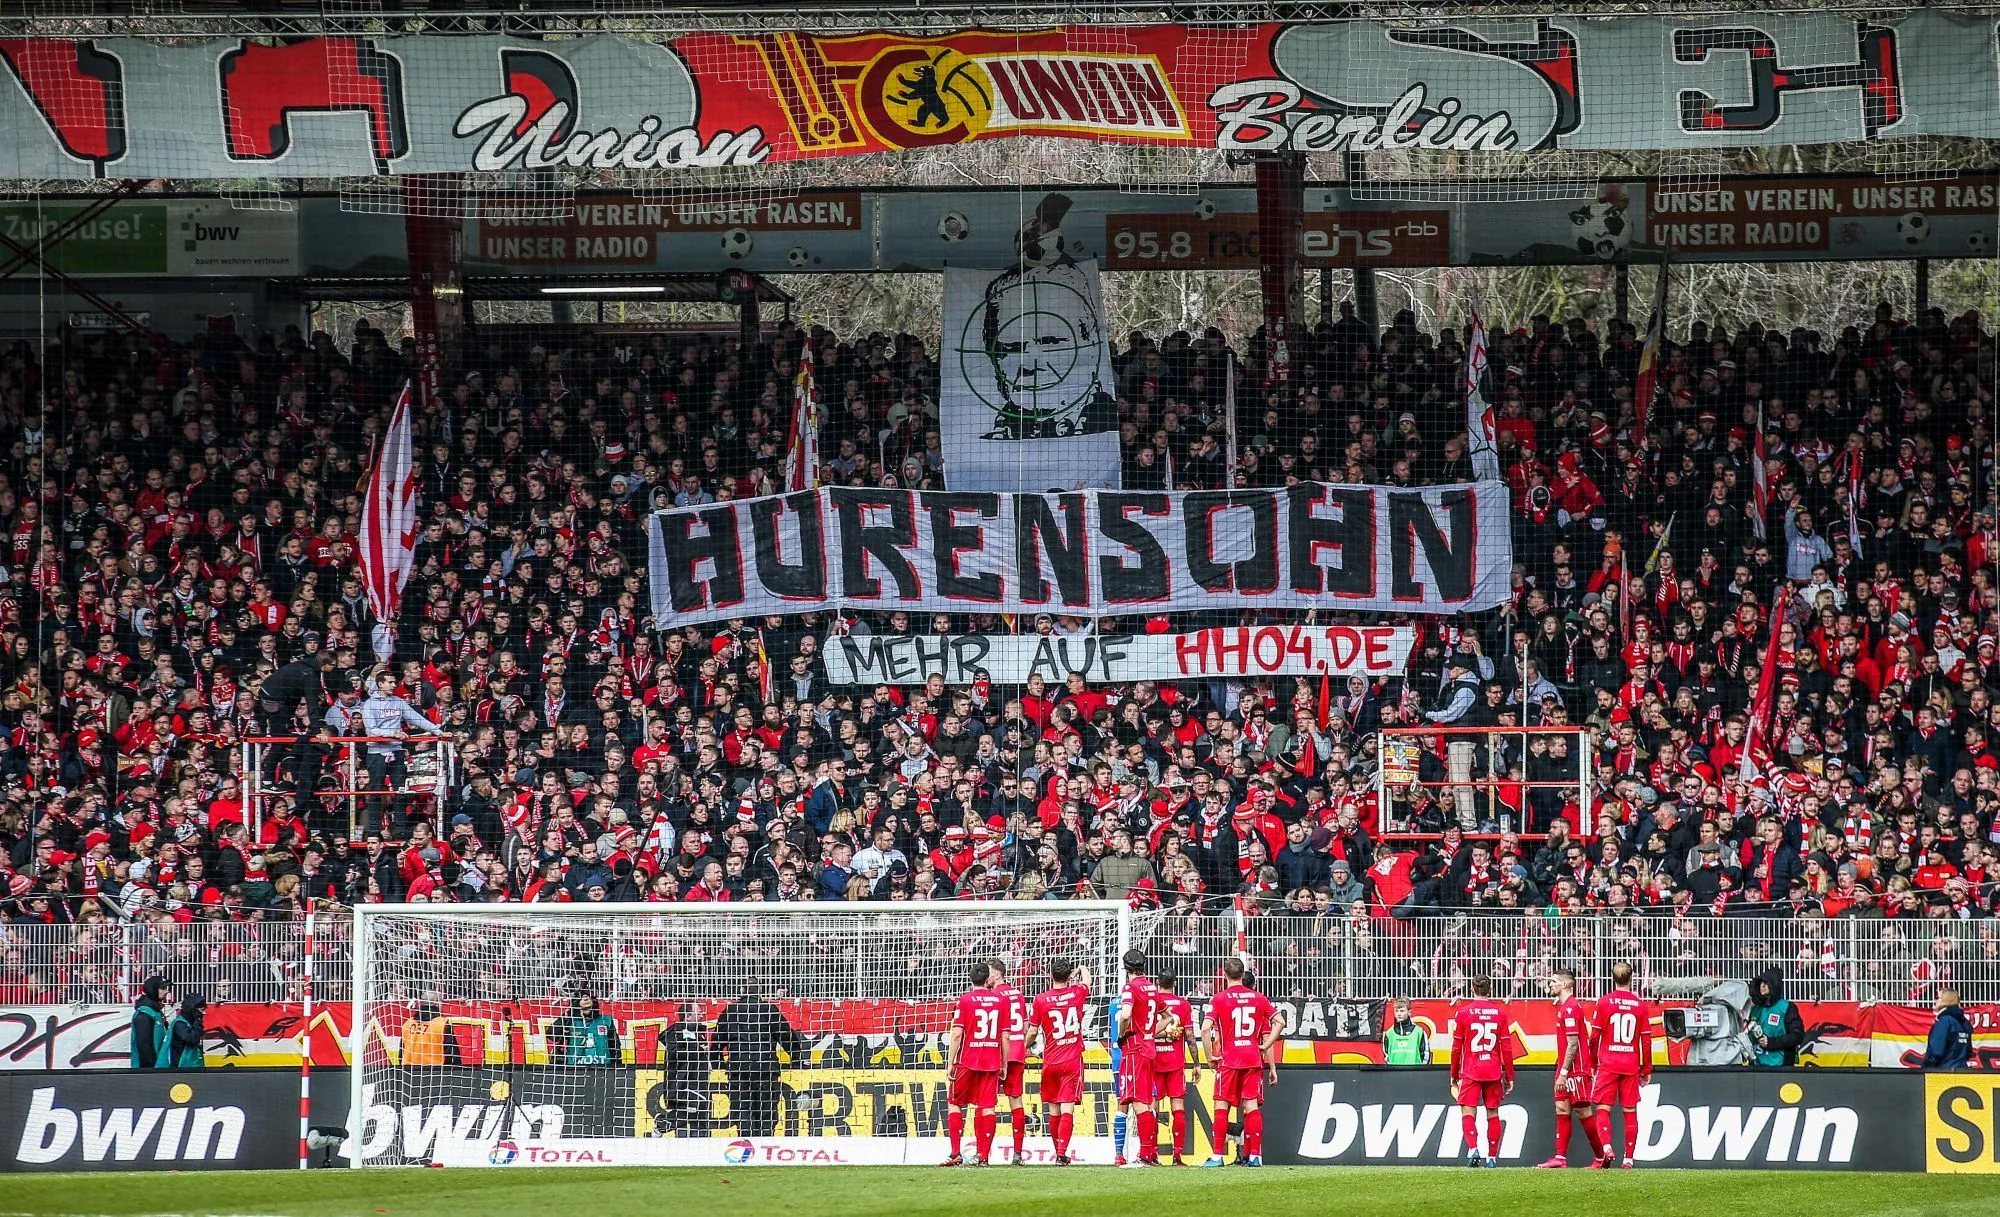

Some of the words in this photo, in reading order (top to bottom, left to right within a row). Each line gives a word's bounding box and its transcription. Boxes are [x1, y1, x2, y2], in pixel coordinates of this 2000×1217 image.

[985, 58, 1180, 128] UNION
[454, 92, 769, 170] Union
[1208, 78, 1520, 152] Berlin
[576, 203, 670, 229] VEREIN,
[678, 203, 757, 225] UNSER
[767, 201, 854, 226] RASEN,
[1654, 190, 1735, 214] UNSER
[1745, 188, 1842, 213] VEREIN,
[1852, 186, 1935, 209] UNSER
[1945, 185, 2000, 207] RAS
[195, 223, 239, 242] bwv
[487, 236, 566, 260] UNSER
[576, 236, 649, 258] RADIO
[1113, 231, 1192, 262] 95,8
[1394, 221, 1438, 236] rbb
[1654, 223, 1735, 247] UNSER
[1745, 221, 1820, 245] RADIO
[658, 480, 1478, 611] HURENSOHN
[842, 632, 990, 686] MEHR
[1033, 633, 1134, 685] AUF
[974, 1009, 999, 1040] 31
[1010, 1002, 1023, 1032] 5
[1047, 1006, 1080, 1040] 34
[1145, 999, 1156, 1031] 3
[1231, 1006, 1256, 1038] 15
[1609, 1012, 1636, 1044] 10
[1470, 1021, 1498, 1052] 25
[15, 1082, 246, 1164] bwin
[338, 1080, 566, 1160] bwin
[1297, 1080, 1529, 1159] bwin
[1634, 1082, 1860, 1163] bwin
[525, 1146, 612, 1163] TOTAL
[760, 1145, 848, 1163] TOTAL
